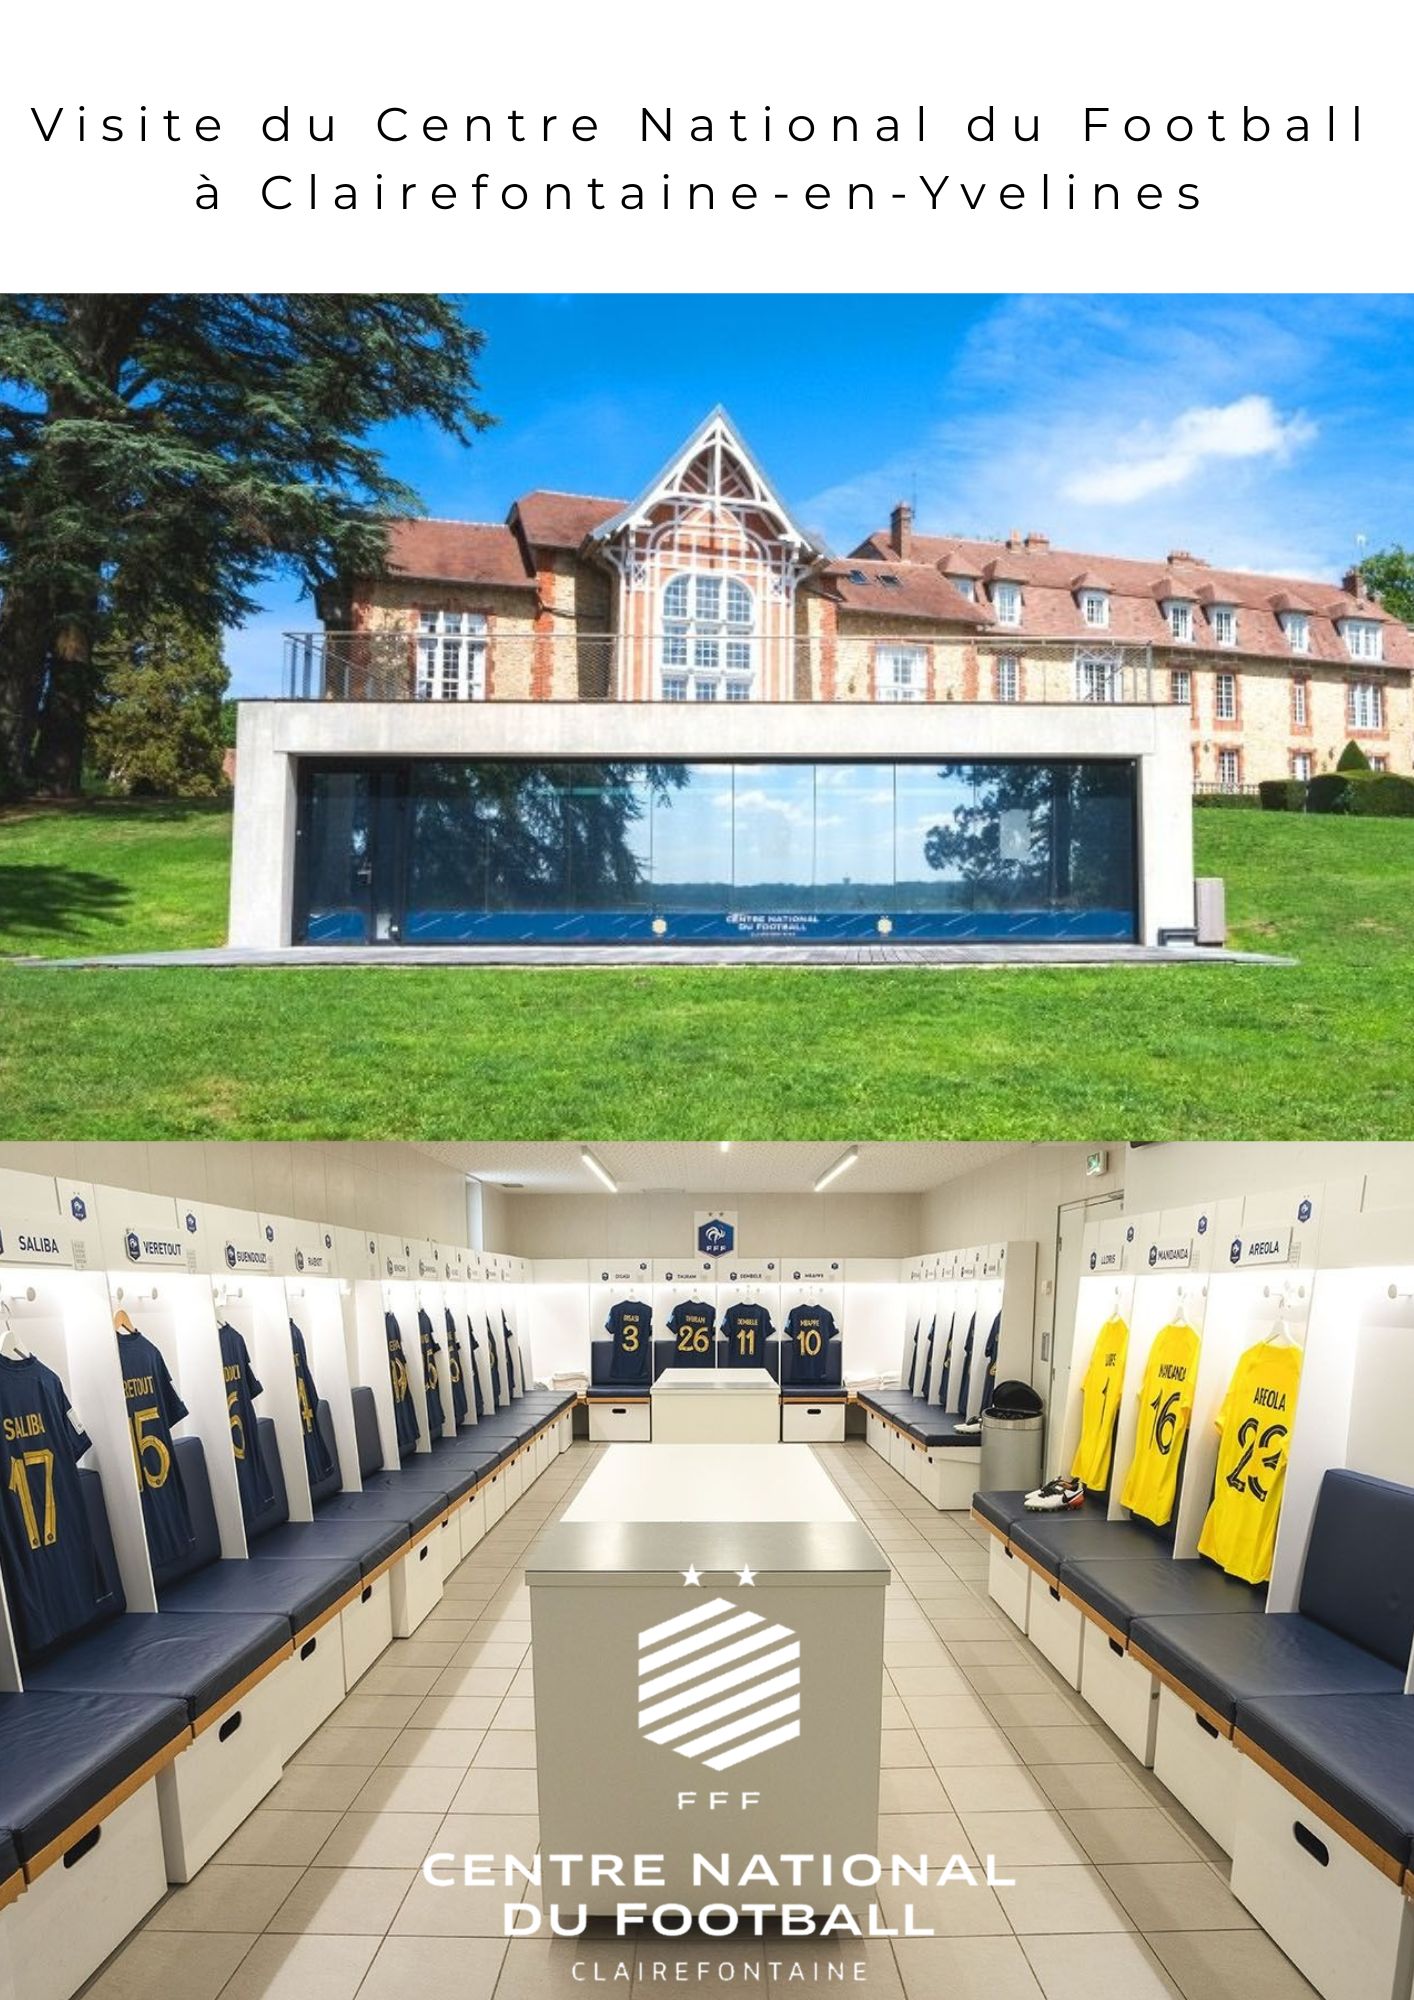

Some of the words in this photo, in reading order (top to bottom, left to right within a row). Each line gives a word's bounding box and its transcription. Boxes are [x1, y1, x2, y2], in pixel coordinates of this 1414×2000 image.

[738, 923, 754, 931] DU
[756, 923, 807, 931] FOOTBALL
[768, 914, 819, 923] NATIONAL
[19, 1235, 60, 1254] SALIBA
[143, 1240, 182, 1256] VERETOUT
[1158, 1248, 1188, 1260] MANDANDA
[1248, 1241, 1280, 1256] AREOLA
[622, 1325, 640, 1352] 3
[677, 1325, 710, 1353] 26
[736, 1329, 755, 1355] 11
[796, 1329, 822, 1356] 10
[3, 1412, 46, 1441] SALIBA
[1148, 1388, 1181, 1456] 16
[8, 1448, 57, 1550] 17
